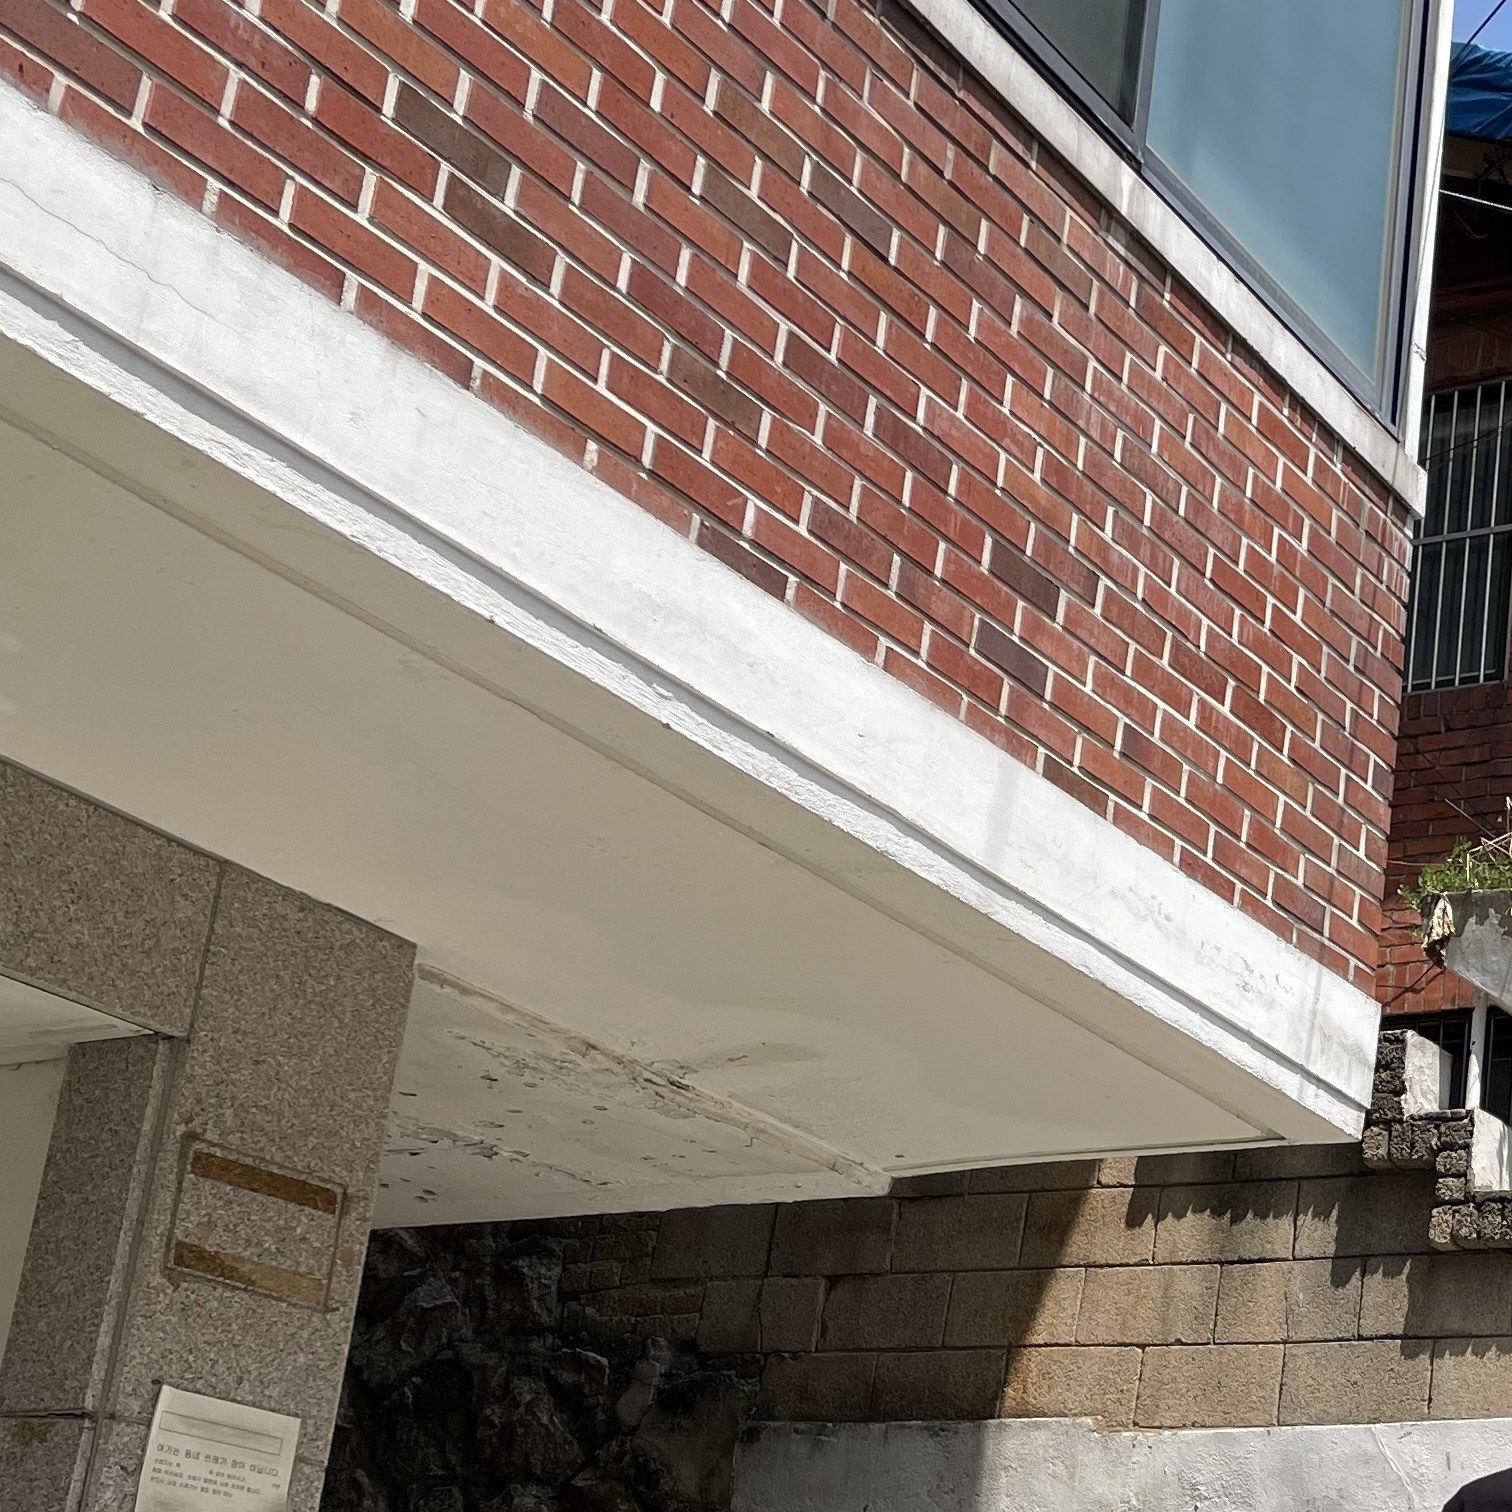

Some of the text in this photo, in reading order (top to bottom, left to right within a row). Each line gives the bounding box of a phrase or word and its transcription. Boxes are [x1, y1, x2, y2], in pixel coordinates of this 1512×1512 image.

[157, 1442, 181, 1457] 여기는
[184, 1448, 200, 1460] 동네
[203, 1454, 227, 1467] 쓰레기
